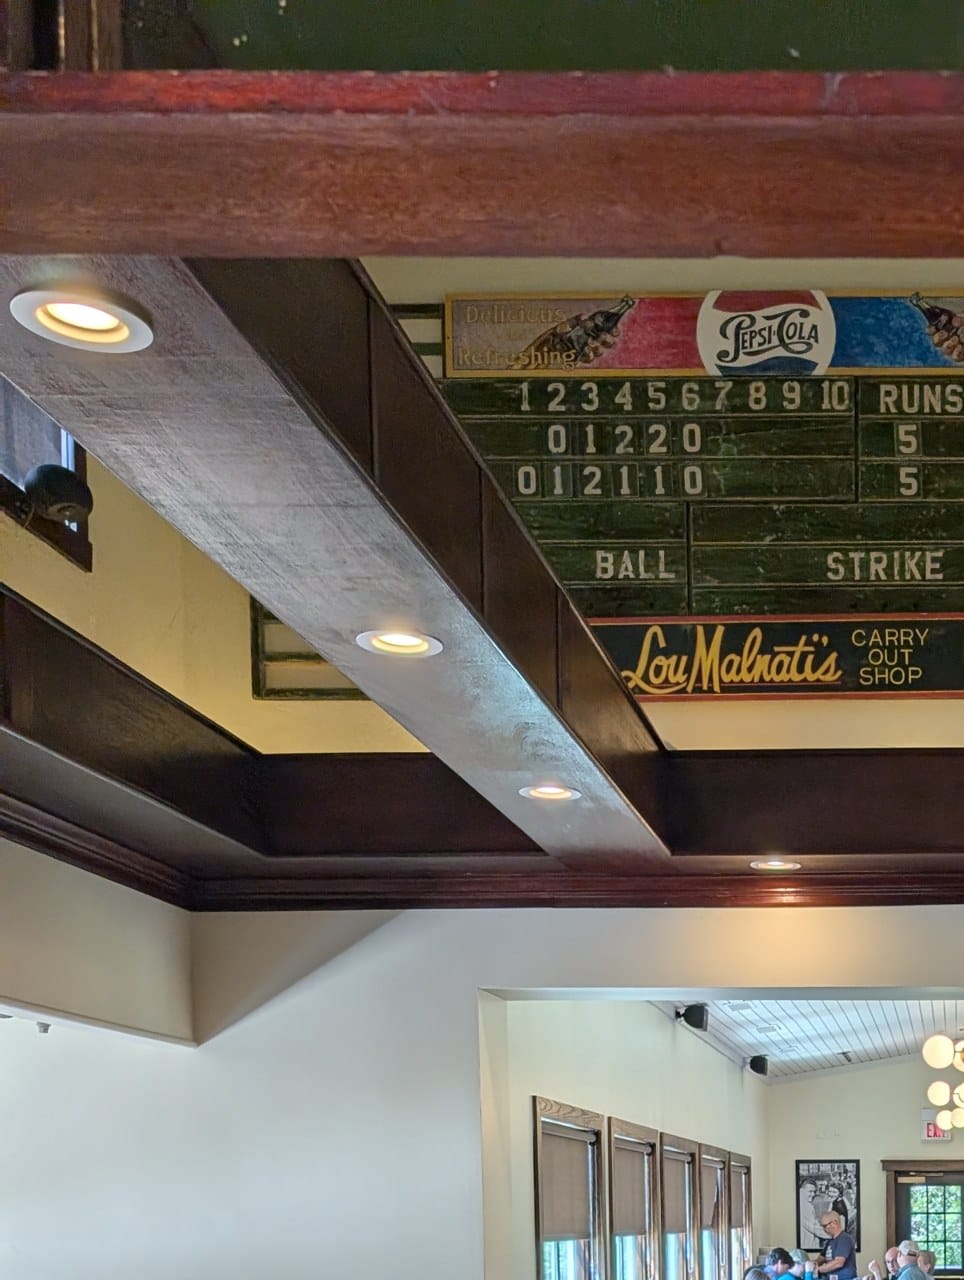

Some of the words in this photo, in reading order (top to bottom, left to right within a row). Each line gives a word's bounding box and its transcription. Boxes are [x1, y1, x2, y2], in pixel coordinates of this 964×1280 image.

[466, 303, 567, 323] Delicious
[458, 347, 577, 371] Refreshing
[519, 382, 531, 411] 1
[547, 382, 566, 411] 2
[581, 382, 599, 411] 3
[614, 381, 632, 411] 4
[648, 381, 666, 411] 5
[682, 381, 700, 411] 6
[714, 381, 733, 410] 7
[748, 381, 766, 410] 8
[782, 381, 801, 410] 9
[821, 381, 850, 410] 10
[879, 385, 963, 413] RUNS
[547, 424, 567, 454] 0
[585, 424, 597, 454] 1
[614, 424, 634, 454] 2
[648, 424, 667, 454] 2
[682, 424, 701, 454] 0
[899, 424, 918, 454] 5
[517, 466, 537, 496] 0
[553, 466, 563, 496] 1
[583, 466, 602, 496] 2
[619, 466, 630, 496] 1
[655, 466, 665, 496] 1
[684, 466, 702, 496] 0
[900, 467, 918, 496] 5
[595, 550, 676, 580] BALL
[826, 552, 944, 581] STRIKE
[851, 628, 928, 648] CARRY
[621, 625, 690, 695] Lou
[686, 625, 844, 694] Malnati's
[867, 649, 914, 666] OUT
[858, 667, 923, 686] SHOP
